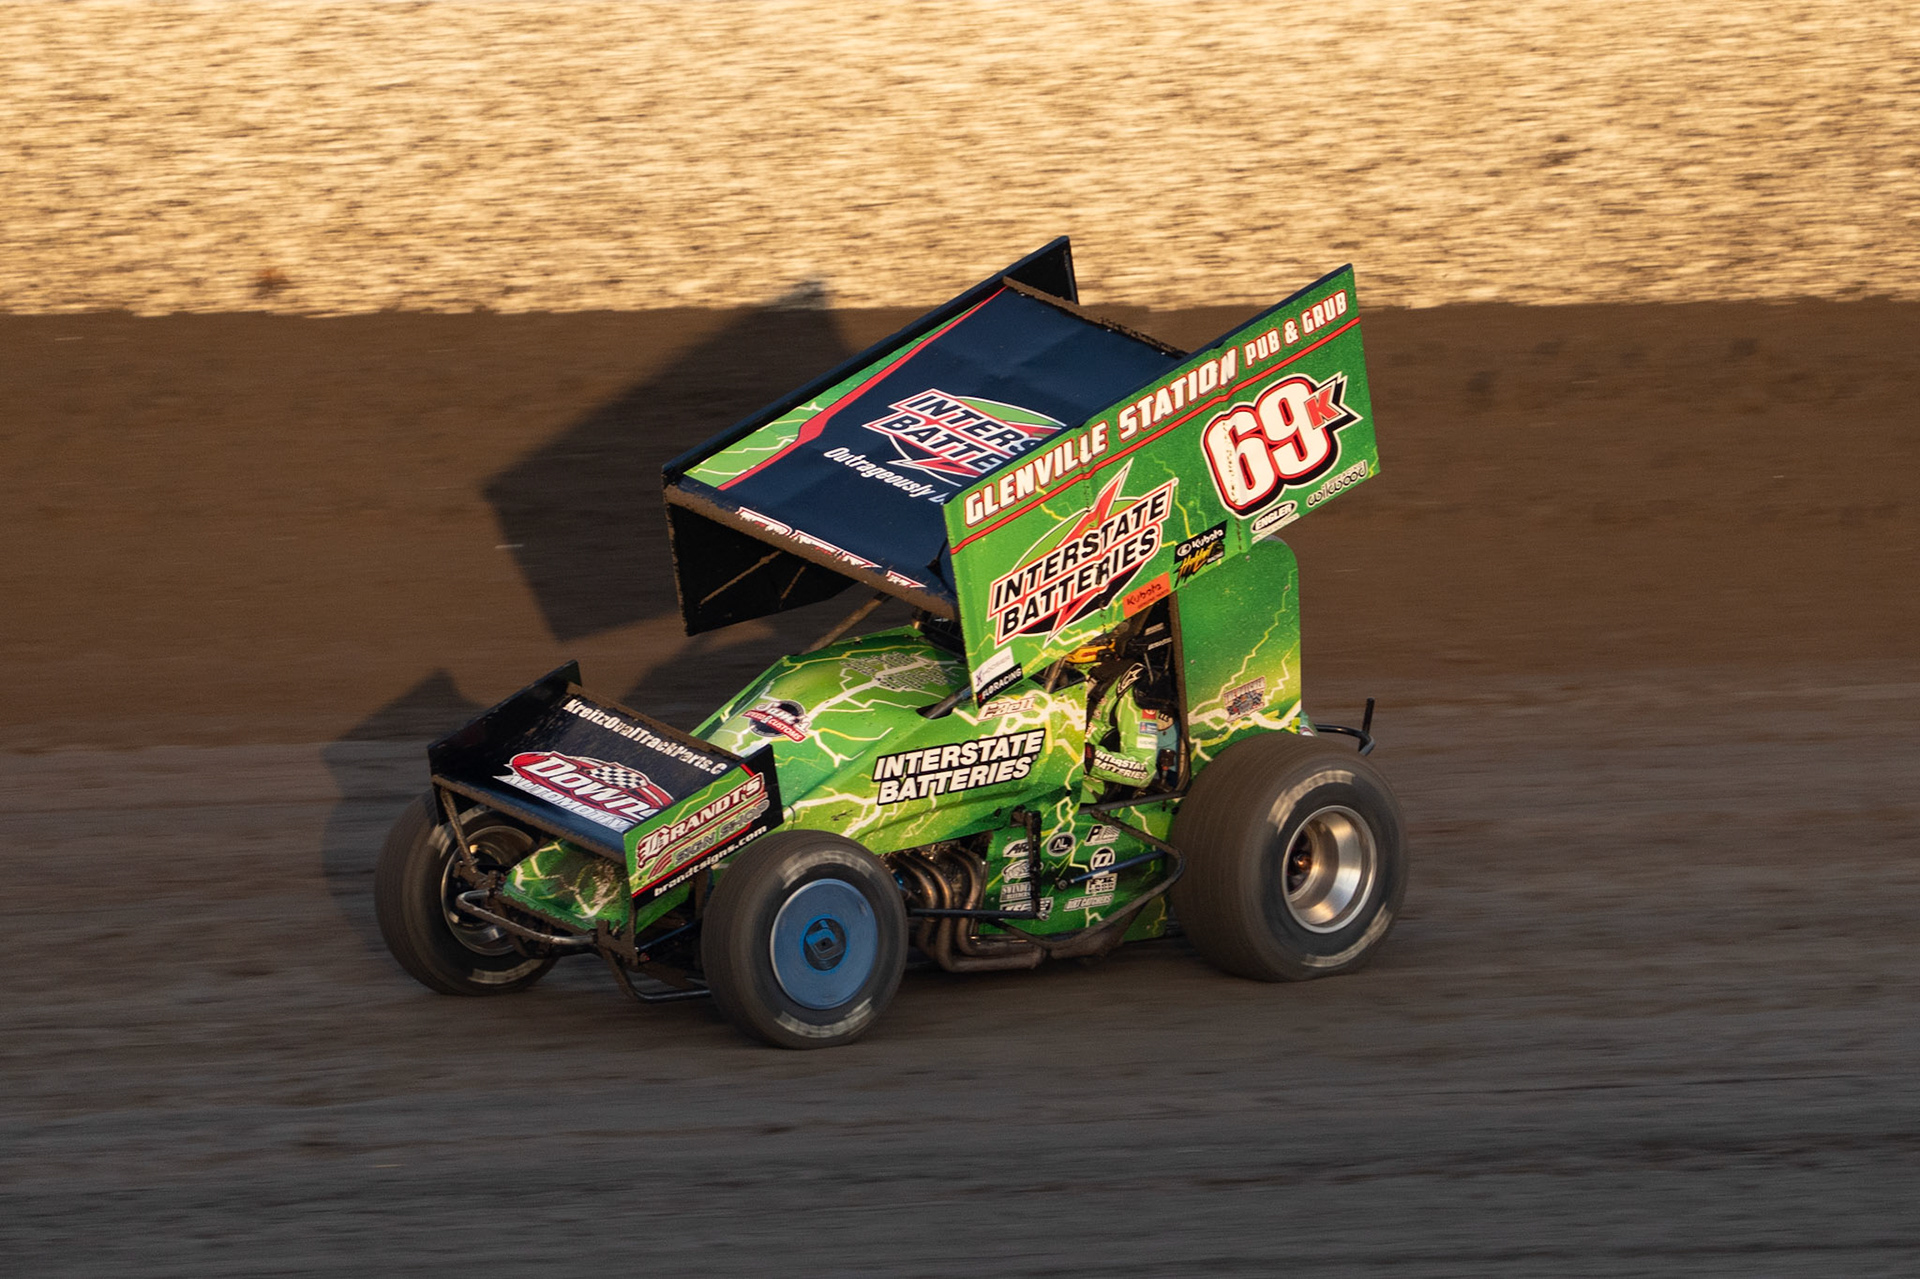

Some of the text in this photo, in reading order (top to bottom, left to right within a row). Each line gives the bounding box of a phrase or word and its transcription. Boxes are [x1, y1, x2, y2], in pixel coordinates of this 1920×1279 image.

[965, 289, 1348, 527] GLENVILLE STATION PUB & GRUB
[823, 446, 937, 498] Outrageously
[1307, 461, 1368, 507] wilwood
[1191, 529, 1224, 549] Kubota
[1254, 502, 1294, 530] ENGLER
[993, 489, 1167, 610] INTERSTATE
[1001, 527, 1156, 637] BATTERIES
[1126, 582, 1162, 606] Kubota
[768, 718, 804, 741] CUSTOMS
[873, 729, 1045, 781] INTERSTATE
[878, 756, 1034, 805] BATTERIES
[1094, 759, 1149, 780] BATTERIES
[638, 774, 764, 868] BRANDT'S
[675, 800, 769, 866] SIGN SHOP
[654, 825, 767, 897] brandtsigns.com
